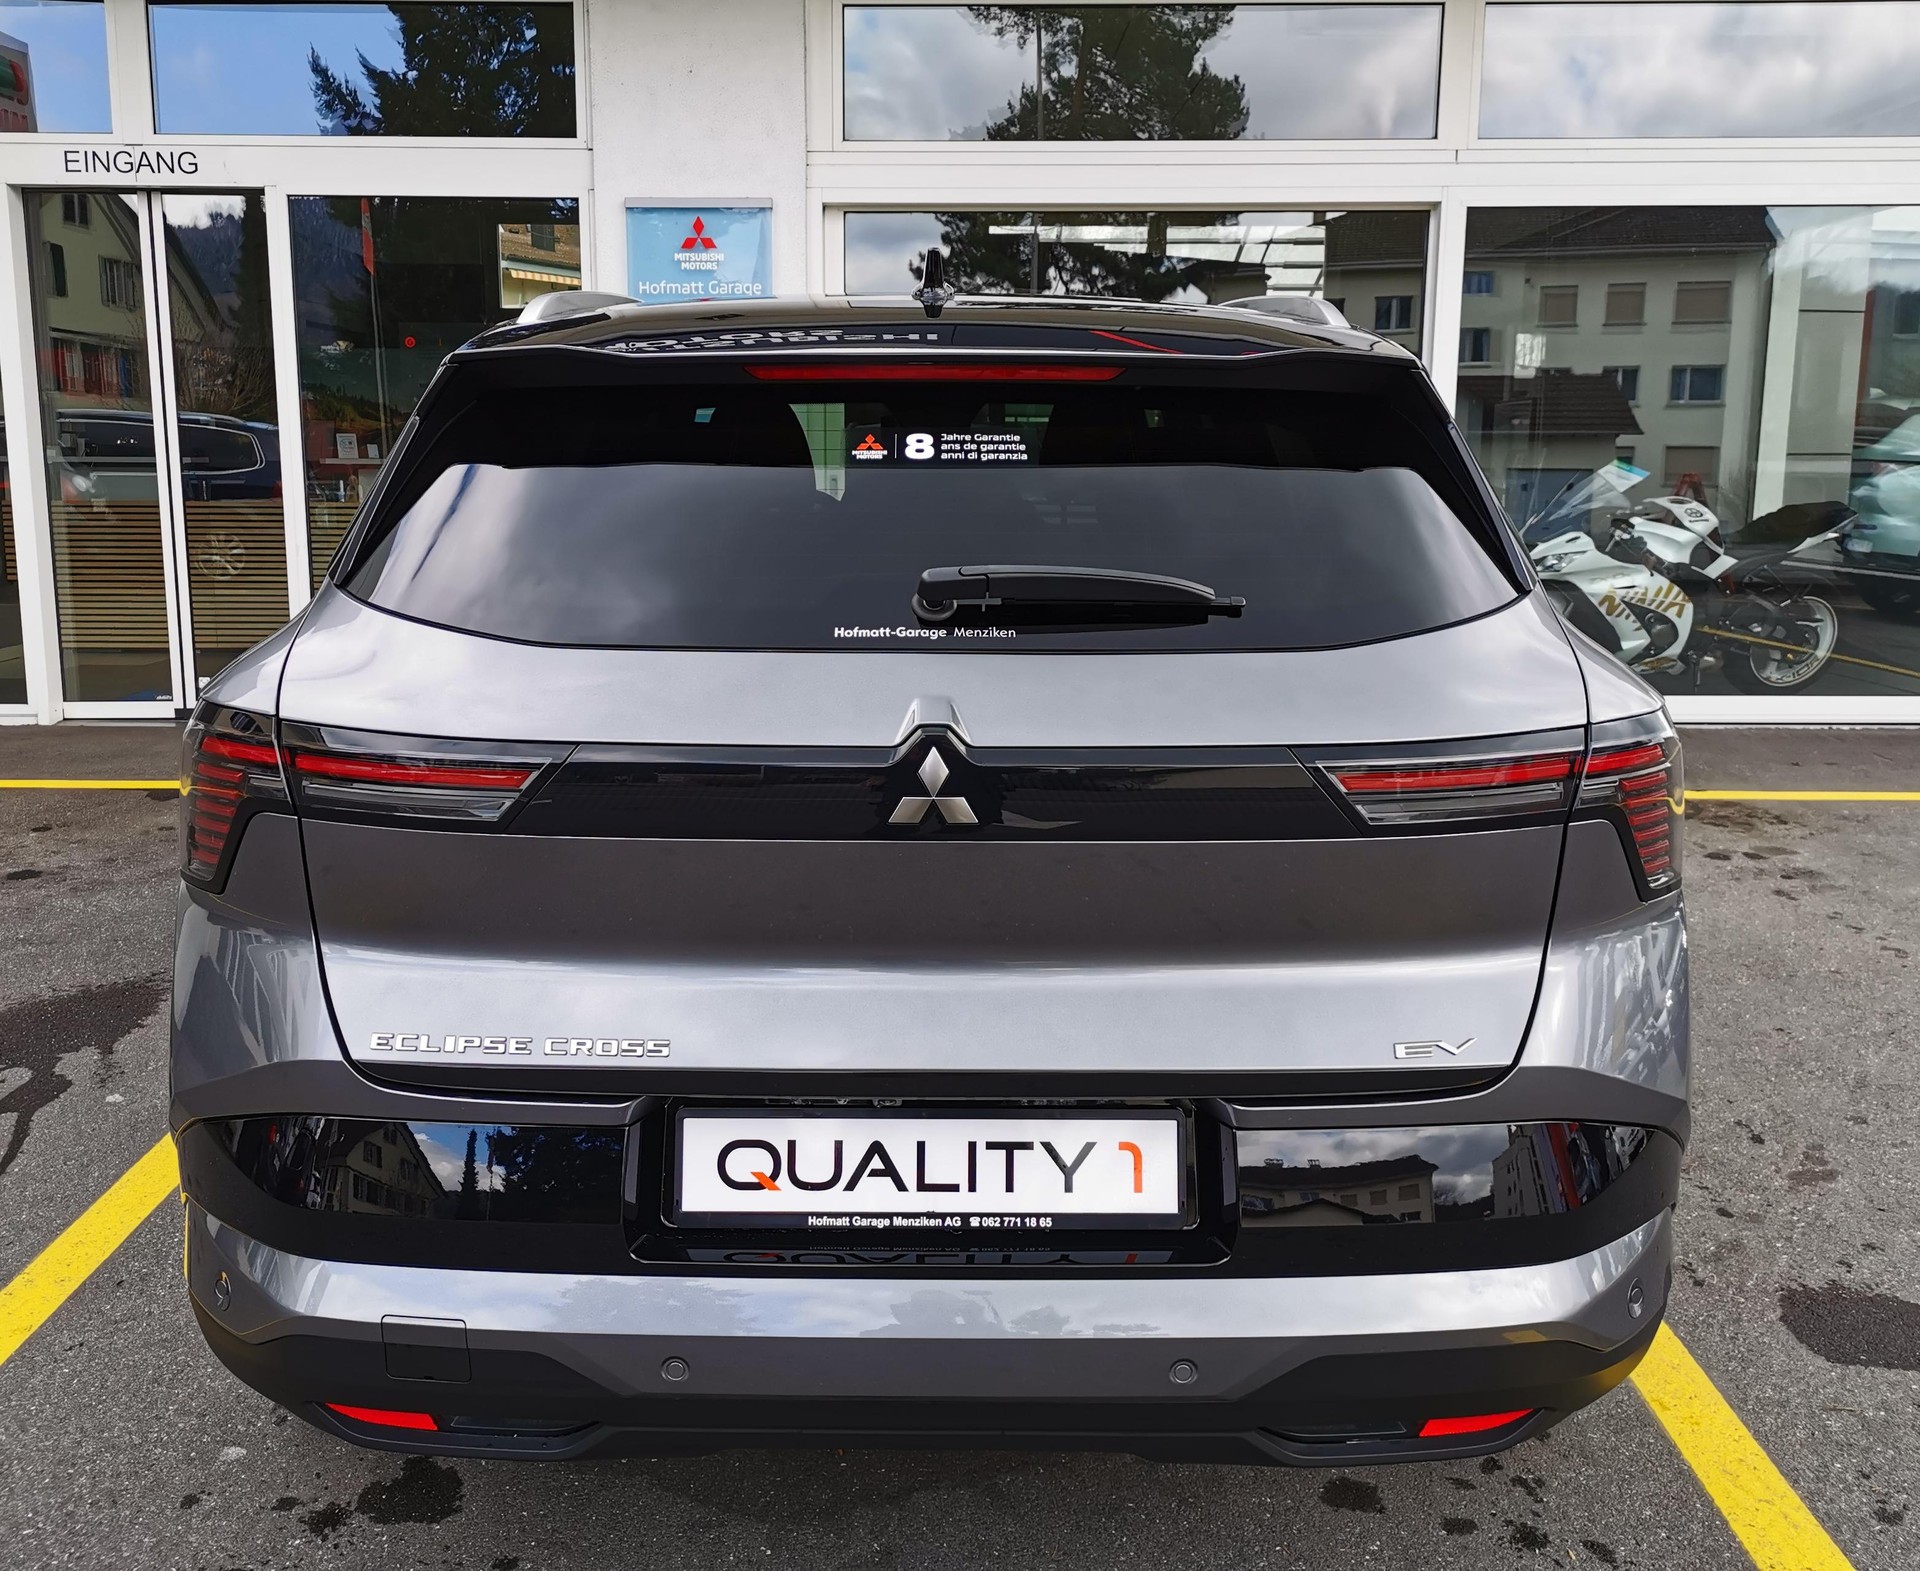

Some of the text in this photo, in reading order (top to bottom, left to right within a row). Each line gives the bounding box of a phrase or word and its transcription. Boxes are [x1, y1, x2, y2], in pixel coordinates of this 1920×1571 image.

[64, 150, 198, 174] EINGANG
[674, 253, 724, 262] MITSUBISHI
[681, 262, 718, 270] MOTORS
[639, 280, 762, 296] Hofmatt Garage
[941, 433, 1020, 441] Jahre Garantie
[904, 433, 935, 459] 8
[964, 442, 977, 450] de
[980, 443, 1026, 452] garantie
[981, 452, 1028, 461] garanzia
[834, 627, 1016, 640] Hofmatt-Garage Menziken
[370, 1032, 671, 1058] ECLIPSE CROSS
[1393, 1038, 1477, 1059] EV
[717, 1139, 1142, 1193] QUALITY 1
[808, 1216, 1052, 1228] Hofmatt Garage Menziken AG 062 771 18 65
